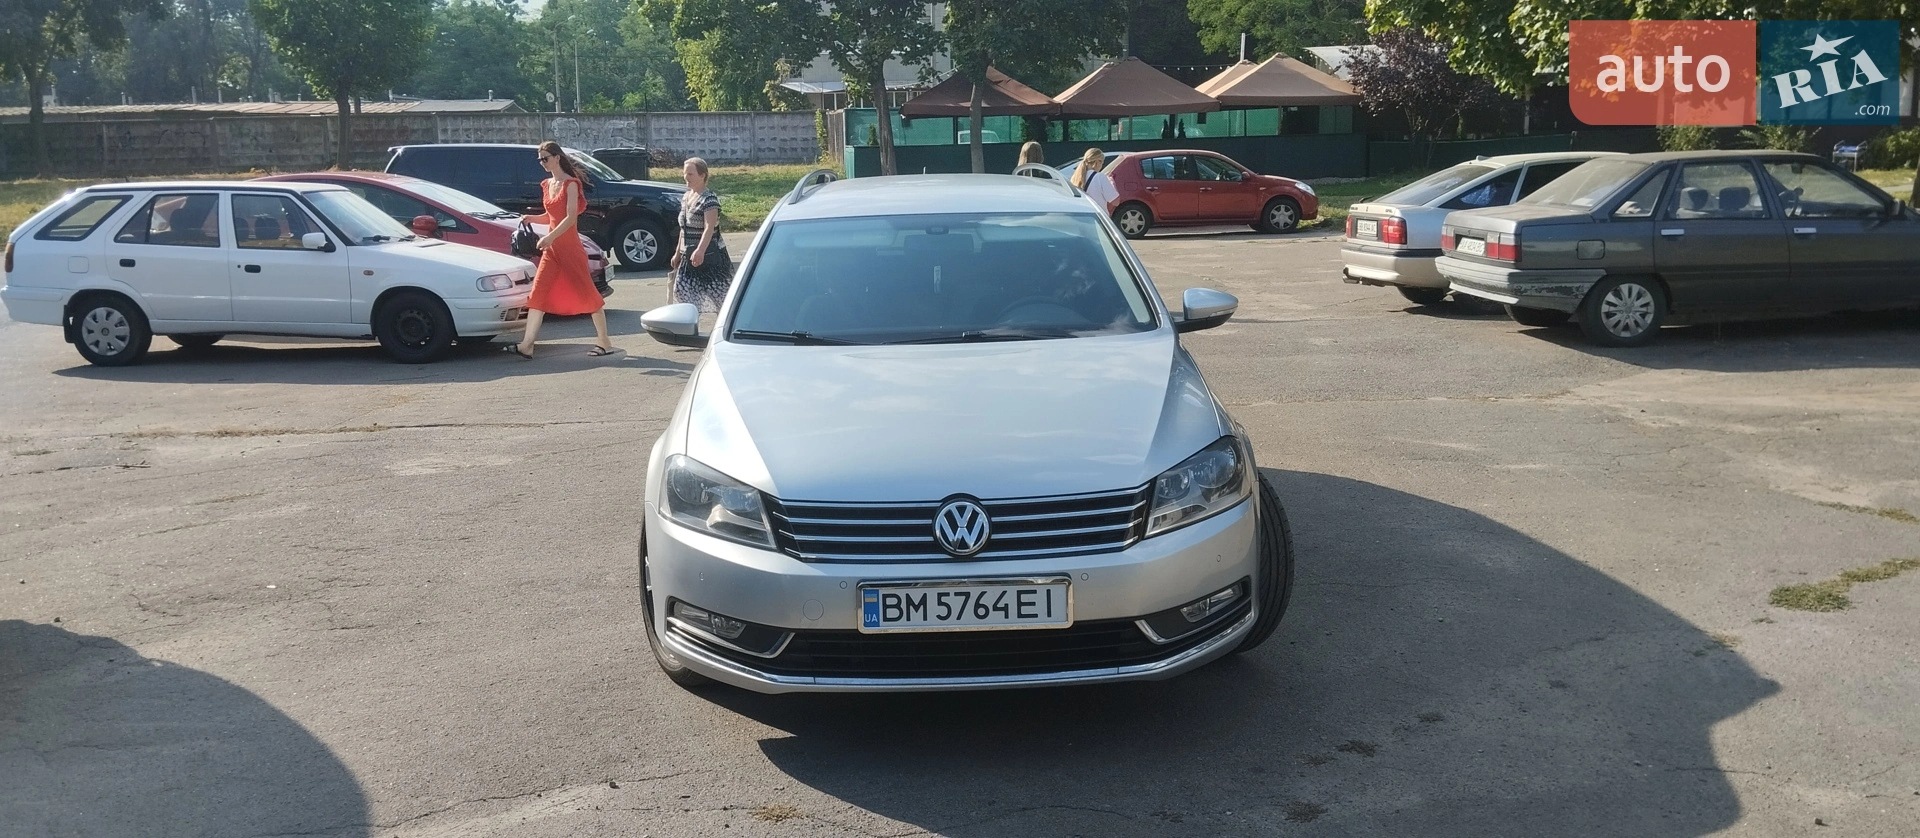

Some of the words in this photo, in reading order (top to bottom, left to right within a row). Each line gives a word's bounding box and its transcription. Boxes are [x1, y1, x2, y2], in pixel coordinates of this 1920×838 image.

[864, 613, 878, 623] UA
[881, 592, 928, 622] BM
[935, 591, 1010, 621] 5764
[1016, 588, 1052, 619] EI
